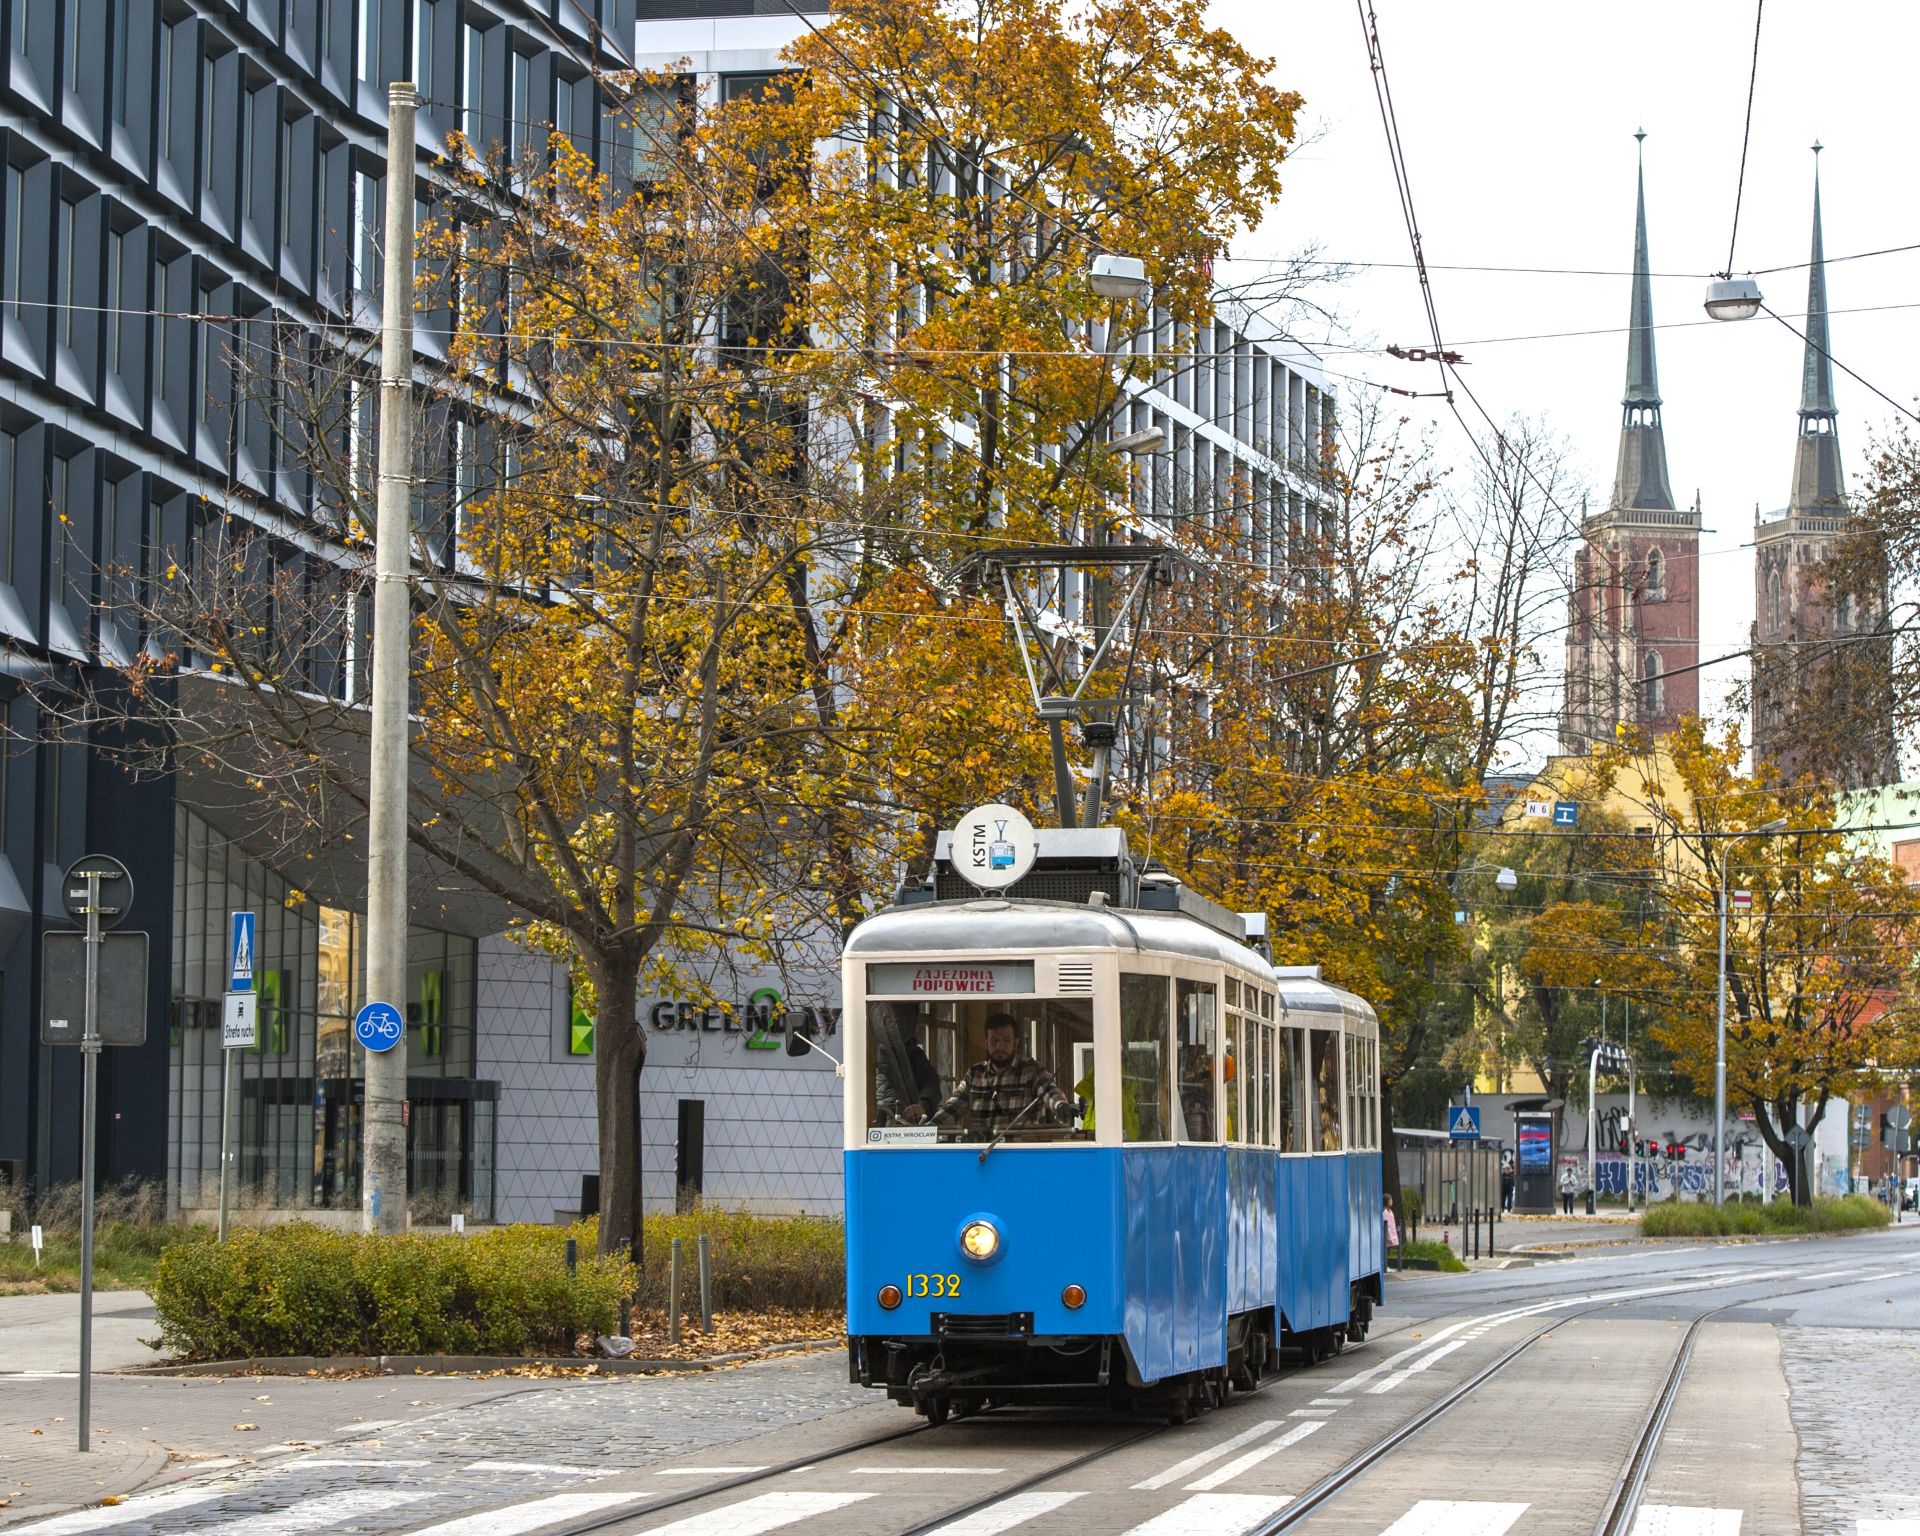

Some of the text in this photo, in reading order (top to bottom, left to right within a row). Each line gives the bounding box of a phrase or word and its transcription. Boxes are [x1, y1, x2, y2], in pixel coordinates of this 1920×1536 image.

[1529, 804, 1548, 814] N 6
[973, 824, 986, 867] KSTM
[915, 968, 994, 980] ZAJEZDNIA
[912, 980, 997, 992] POPOWICE
[225, 1024, 240, 1039] Strefa
[906, 1273, 961, 1298] 1332
